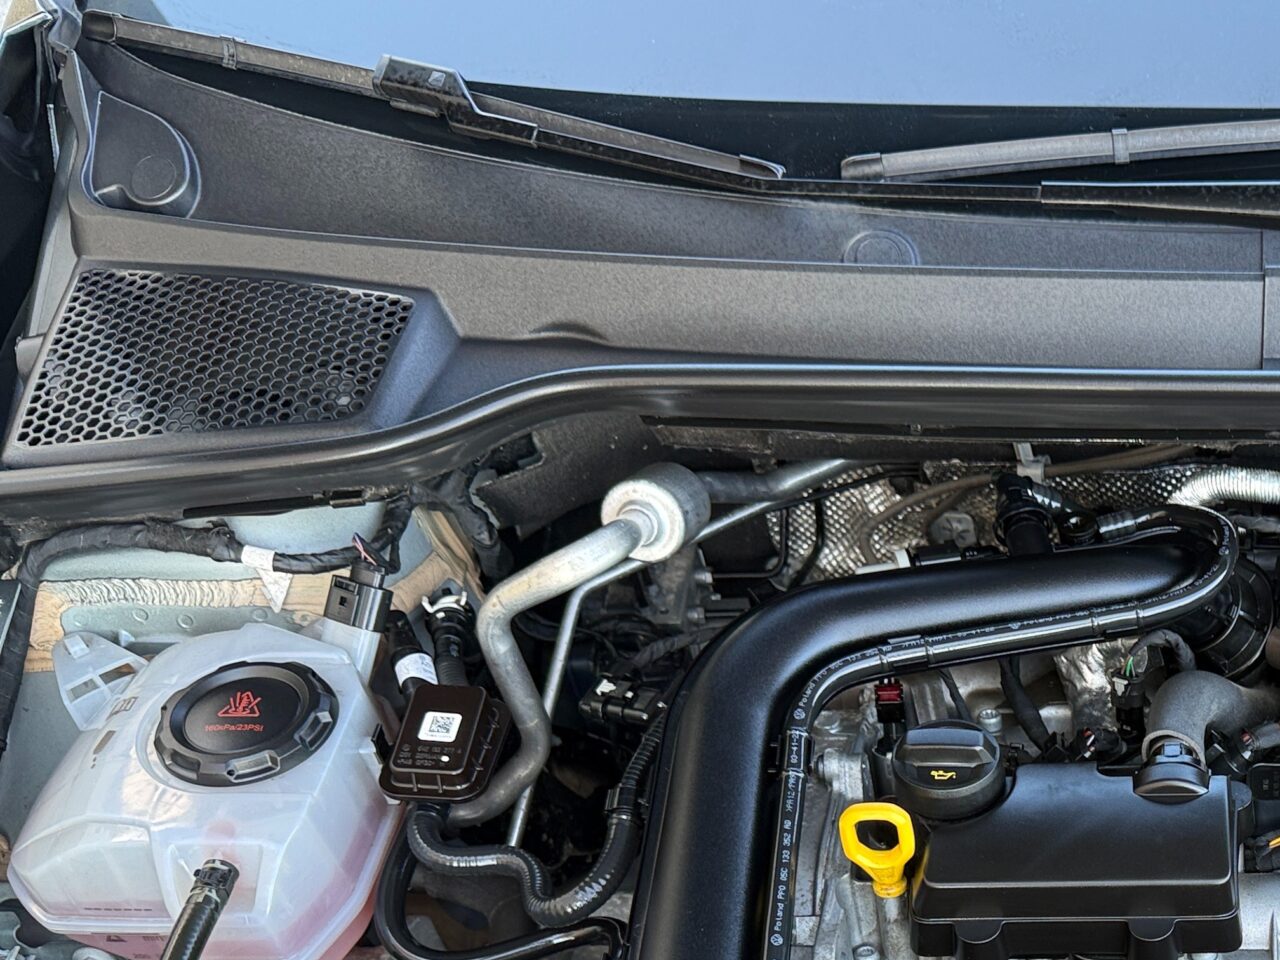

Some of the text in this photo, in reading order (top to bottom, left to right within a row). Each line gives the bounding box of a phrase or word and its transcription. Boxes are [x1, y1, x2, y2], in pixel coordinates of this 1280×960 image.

[782, 832, 792, 847] 352
[782, 849, 790, 864] 133
[773, 901, 785, 932] Poland
